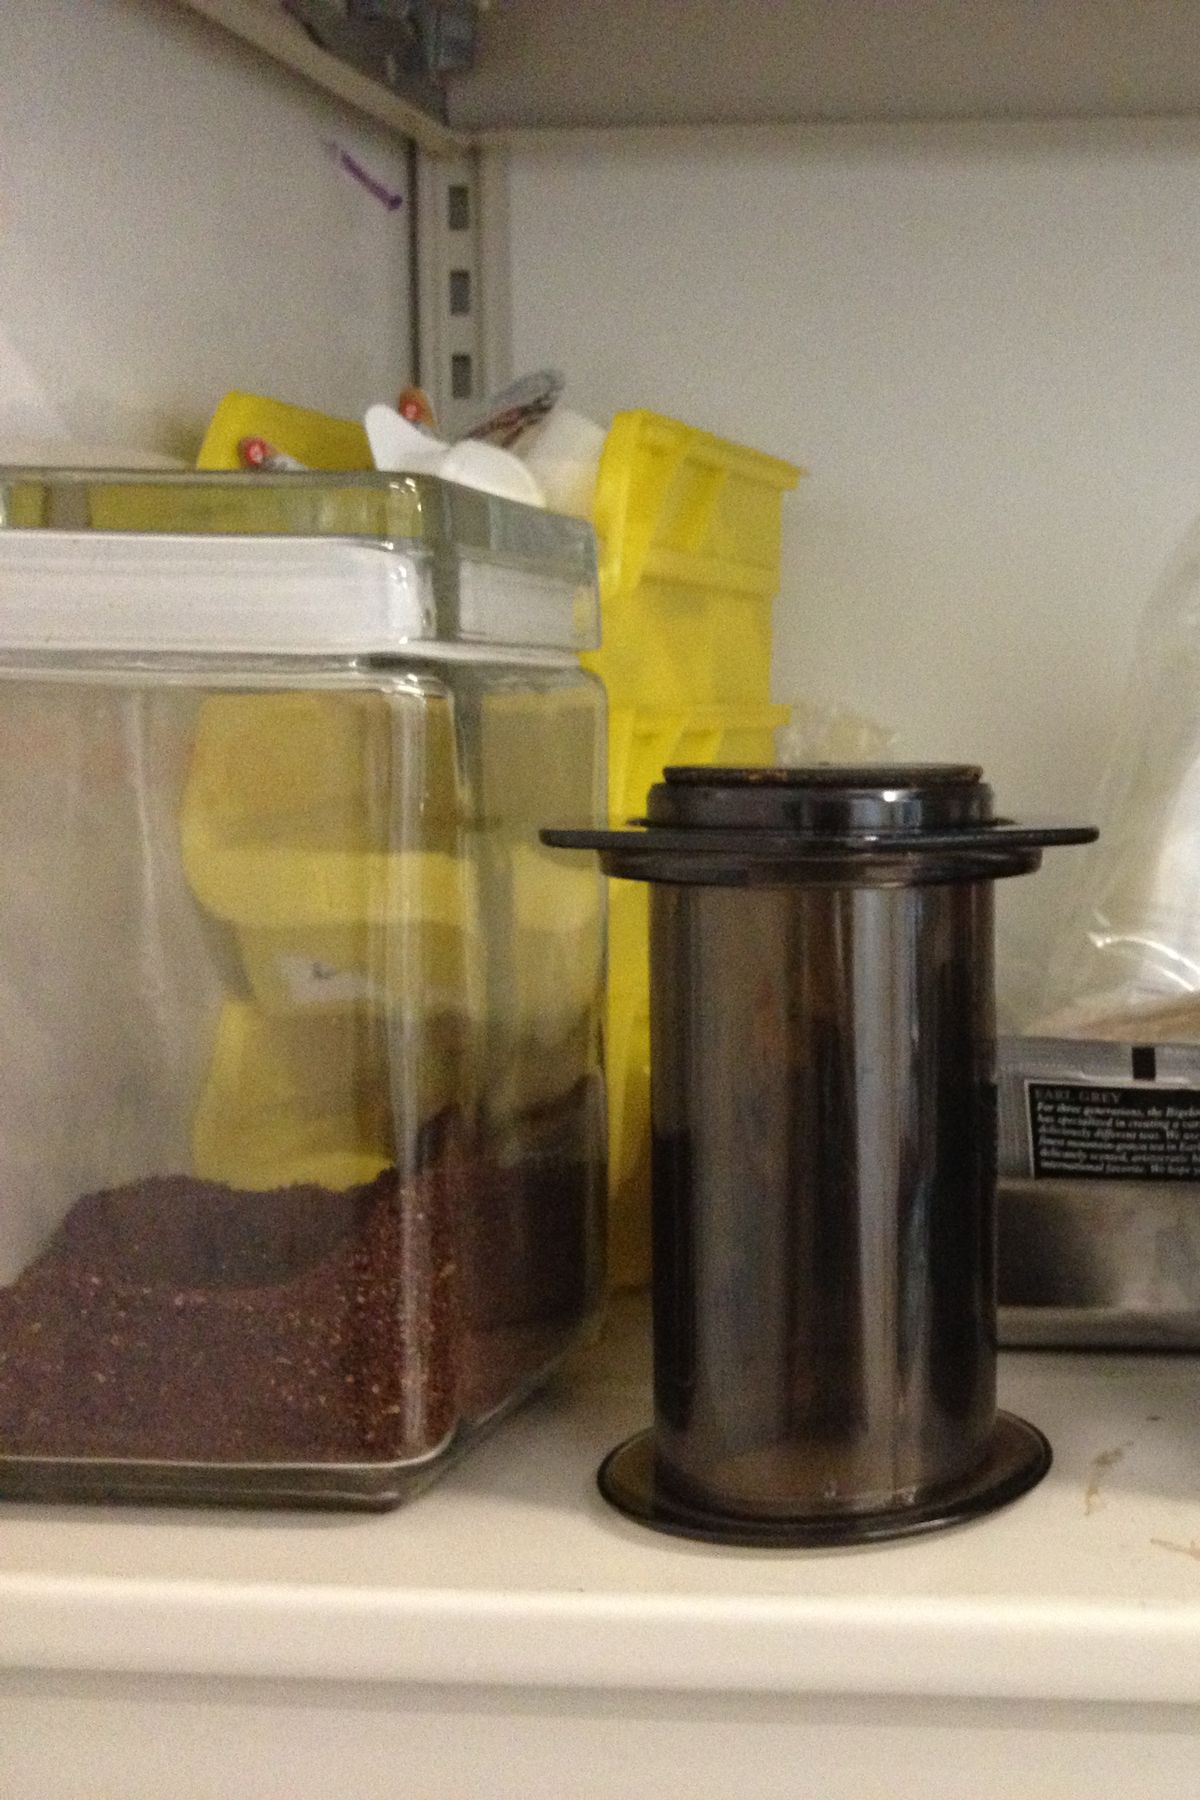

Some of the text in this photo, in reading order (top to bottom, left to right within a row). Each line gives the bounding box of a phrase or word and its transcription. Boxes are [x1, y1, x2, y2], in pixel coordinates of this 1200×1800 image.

[1079, 1090, 1121, 1103] GREY
[1037, 1102, 1054, 1112] For
[1147, 1105, 1163, 1117] the
